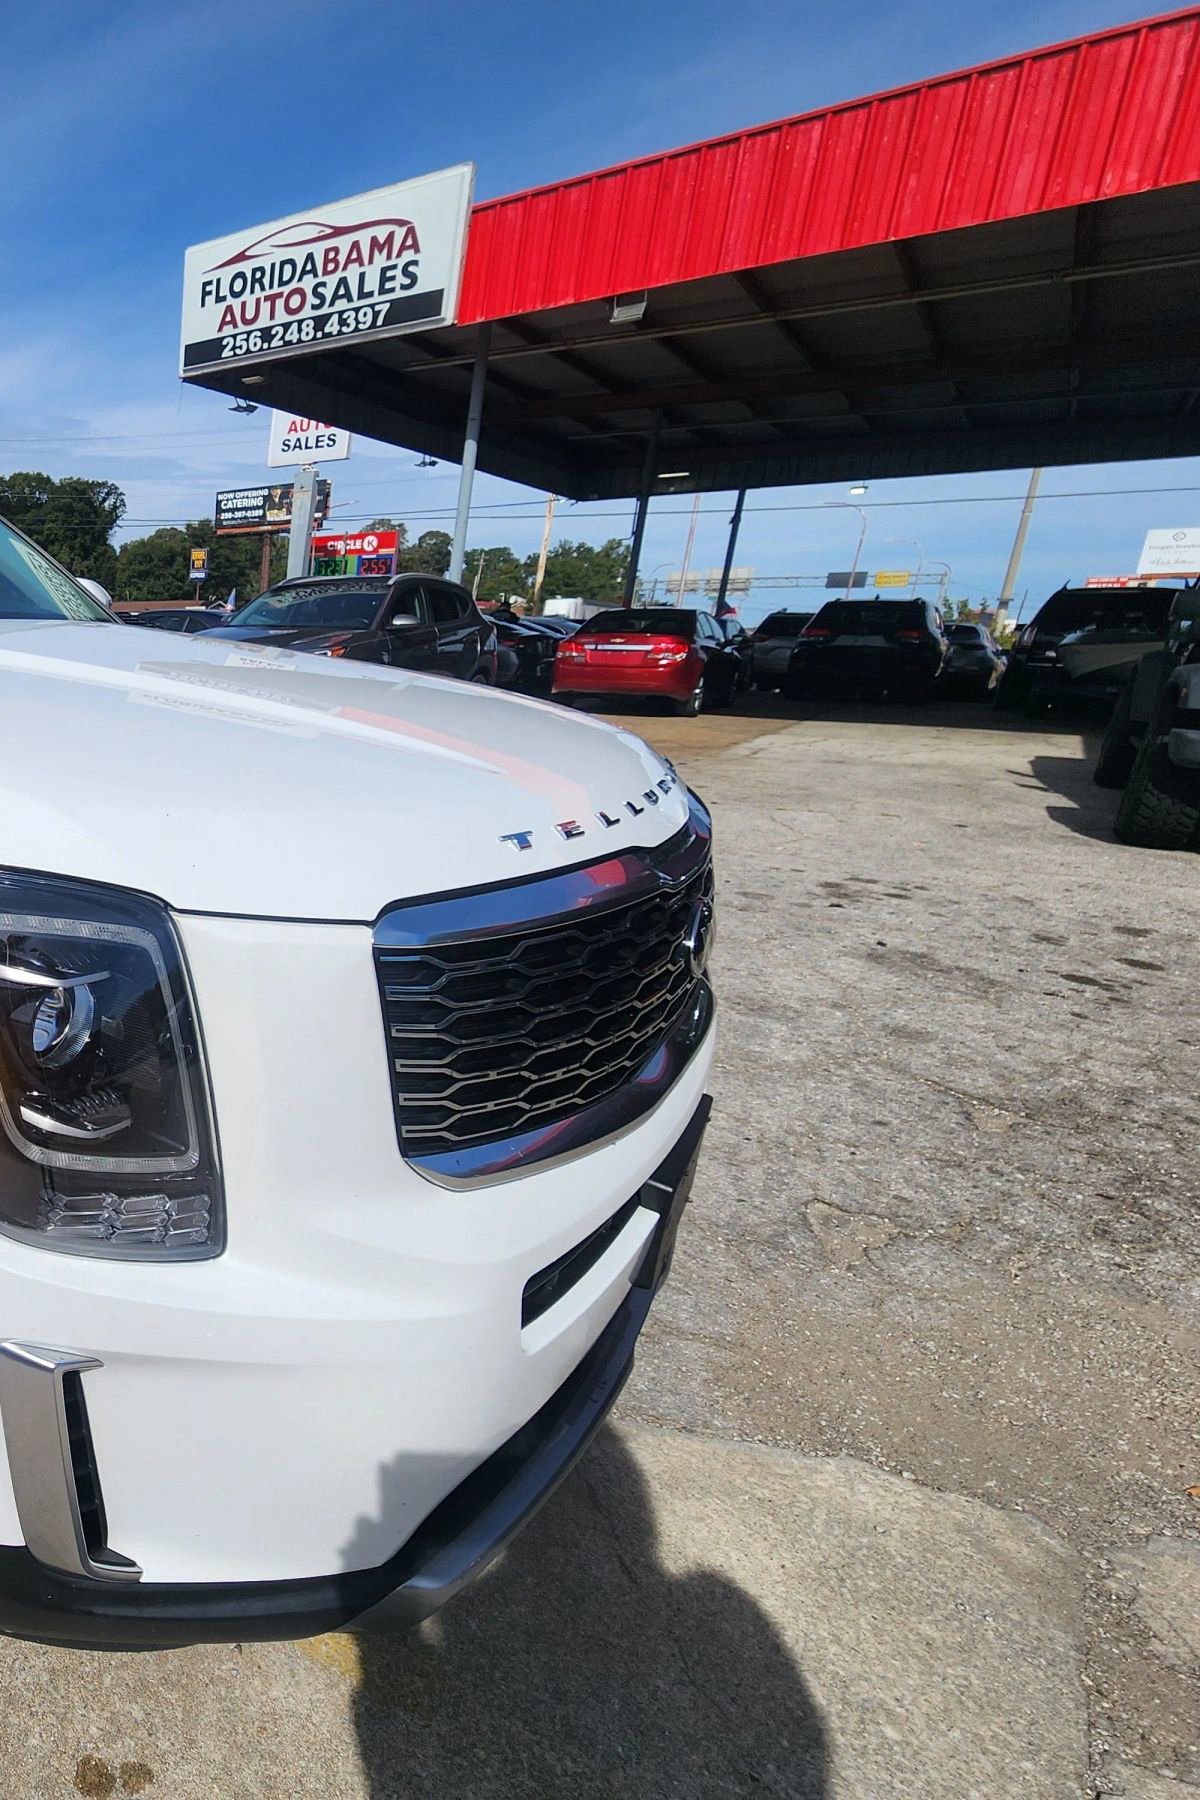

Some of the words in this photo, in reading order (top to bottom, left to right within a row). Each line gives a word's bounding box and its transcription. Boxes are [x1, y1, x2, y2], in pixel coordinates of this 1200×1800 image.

[201, 225, 421, 307] FLORIDABAMA
[217, 259, 419, 332] AUTOSALES
[221, 302, 391, 358] 256.248.4397
[281, 433, 337, 453] SALES
[218, 492, 234, 501] NOW
[235, 488, 269, 499] OFFERING
[221, 497, 264, 509] CATERING
